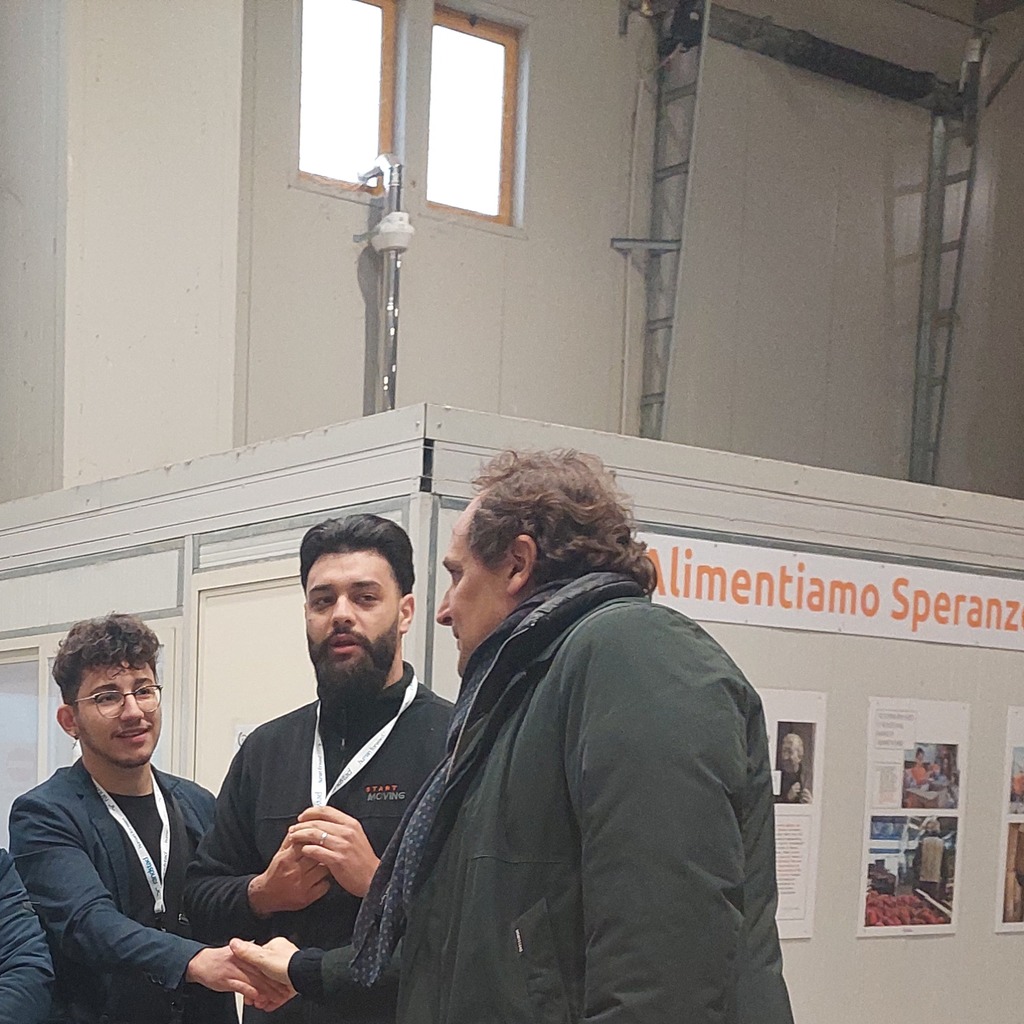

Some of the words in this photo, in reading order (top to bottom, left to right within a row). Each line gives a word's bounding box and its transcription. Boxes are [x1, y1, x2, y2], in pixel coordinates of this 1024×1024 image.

[891, 576, 1024, 633] Speranz
[365, 784, 398, 792] START
[367, 791, 406, 801] MOVING
